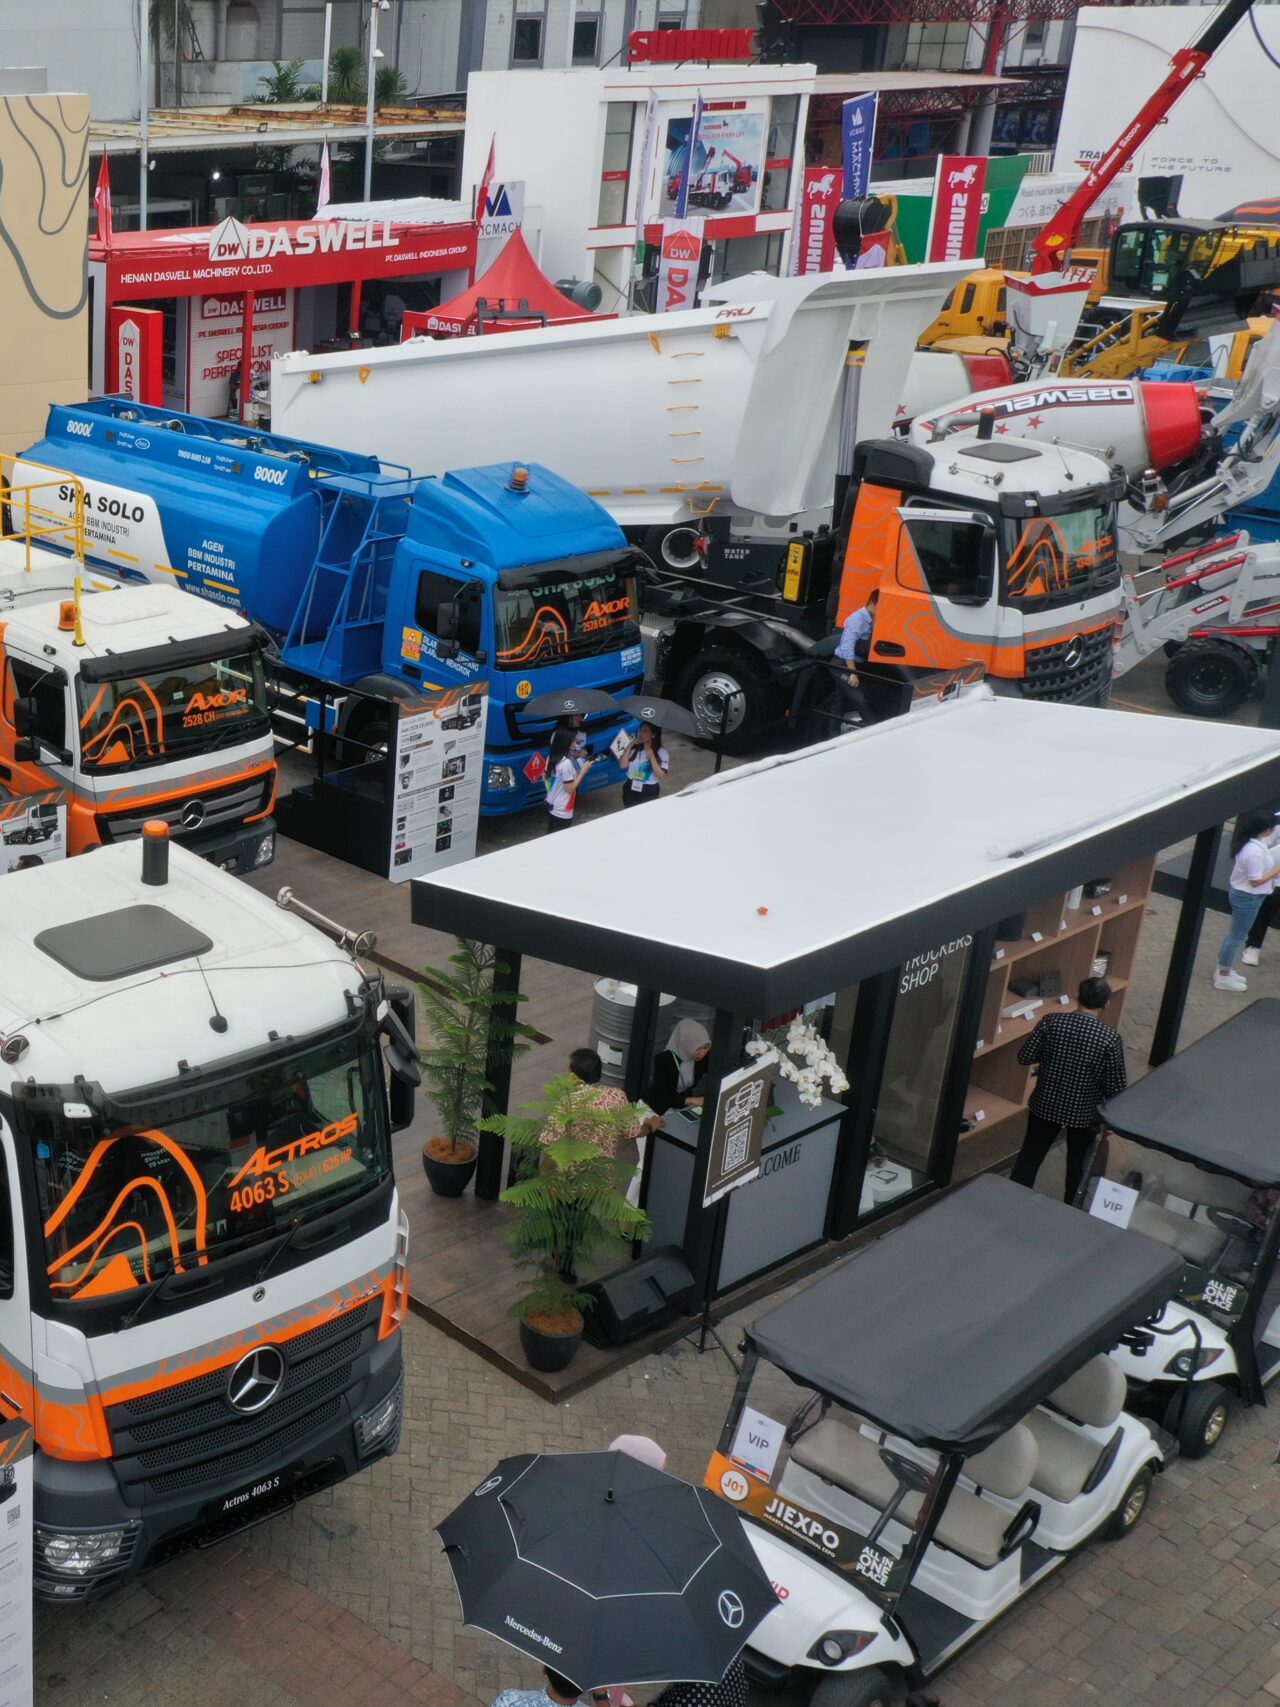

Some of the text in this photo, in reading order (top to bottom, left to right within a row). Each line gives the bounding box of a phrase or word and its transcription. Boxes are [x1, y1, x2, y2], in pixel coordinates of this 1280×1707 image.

[1151, 156, 1194, 164] FORCE
[247, 220, 400, 259] DASWELL
[394, 251, 418, 262] DASWELL
[419, 249, 447, 260] INDONESIA
[448, 246, 467, 257] GROUP
[670, 248, 690, 258] DW
[121, 272, 152, 284] HENAN
[153, 270, 191, 282] DASWELL
[192, 267, 240, 280] MACHINERY
[97, 496, 145, 524] SOLO
[84, 528, 117, 545] ERTAMINA
[101, 519, 130, 538] INDUSTRI
[202, 539, 224, 553] AGEN
[187, 547, 236, 570] BBM INDUSTRI
[187, 560, 234, 582] PERTAMINA
[185, 582, 242, 608] www.shasolo.com
[582, 622, 598, 632] 2528
[182, 712, 203, 728] 2528
[204, 710, 216, 723] CH
[900, 963, 939, 994] SHOP
[227, 1112, 360, 1188] ACTROS
[230, 1178, 276, 1213] 4063
[277, 1170, 290, 1195] S
[322, 1154, 340, 1173] 625
[340, 1148, 352, 1164] HP
[1103, 1198, 1123, 1212] VIP
[1205, 1286, 1235, 1303] ONE
[1207, 1279, 1237, 1296] ALL IN
[1202, 1294, 1233, 1312] PLACE
[748, 1431, 770, 1450] VIP
[223, 1476, 280, 1511] Actros 4063 S
[723, 1477, 744, 1495] J01
[765, 1498, 839, 1549] JIEXPO
[763, 1512, 836, 1558] JAKARTA INTERNATIONAL EXPO
[859, 1552, 891, 1577] ONE
[862, 1545, 894, 1569] ALL IN
[855, 1562, 888, 1588] PLACE
[504, 1615, 563, 1655] Mercedes-Benz
